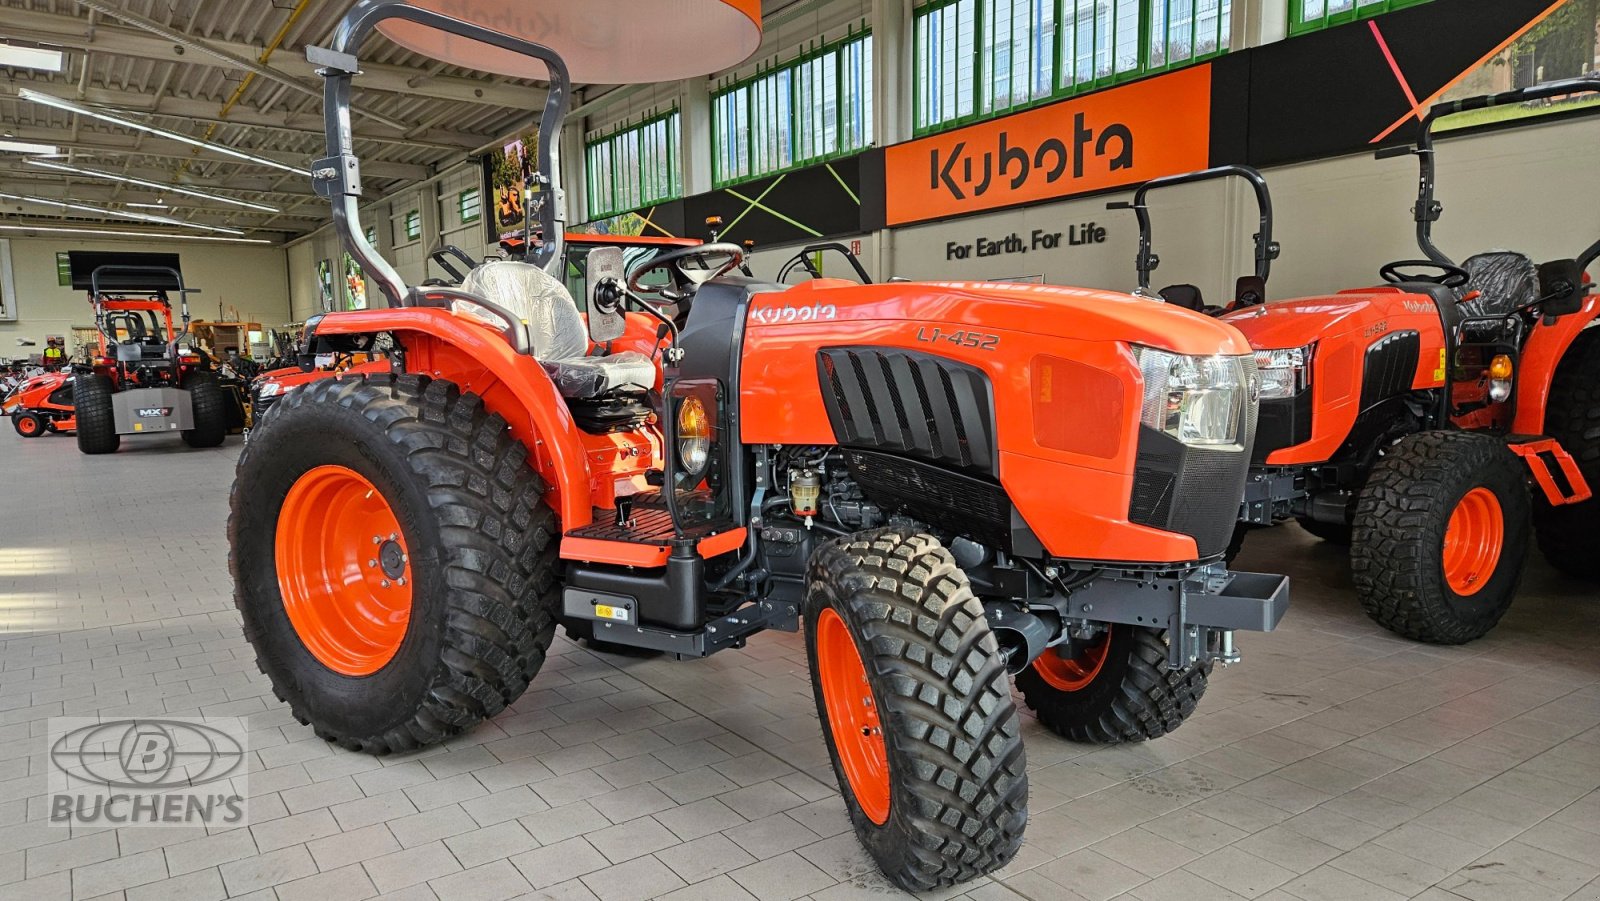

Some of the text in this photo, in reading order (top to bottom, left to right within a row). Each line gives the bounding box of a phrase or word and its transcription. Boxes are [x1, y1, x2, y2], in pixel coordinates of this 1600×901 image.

[931, 112, 1133, 200] Kubota
[946, 222, 1106, 260] For Earth, For Life
[751, 301, 836, 323] Kubota
[917, 327, 1000, 351] L1-452
